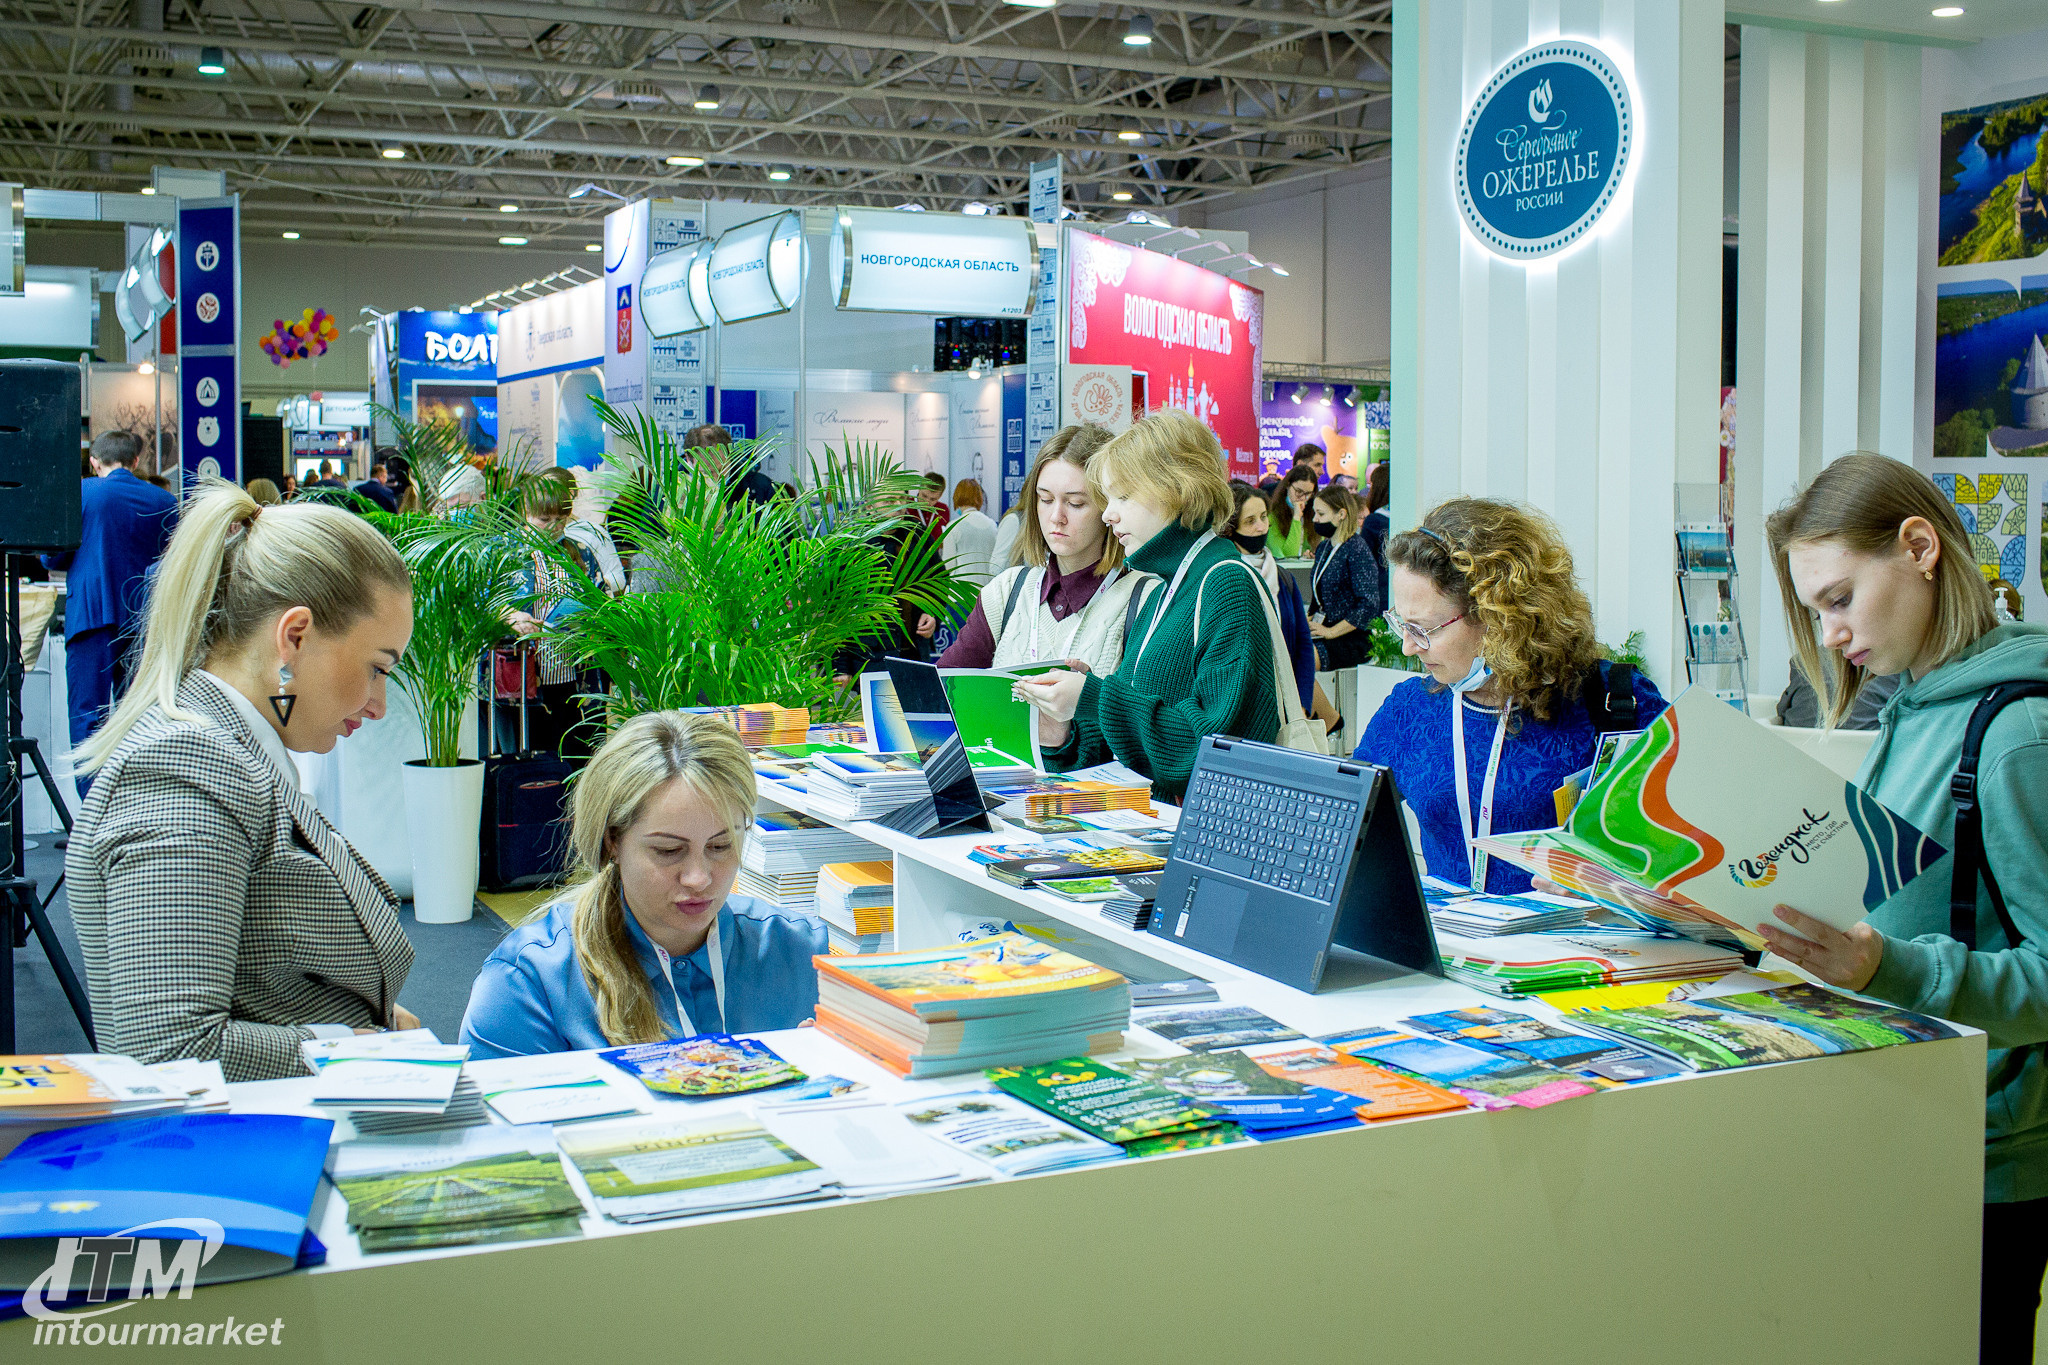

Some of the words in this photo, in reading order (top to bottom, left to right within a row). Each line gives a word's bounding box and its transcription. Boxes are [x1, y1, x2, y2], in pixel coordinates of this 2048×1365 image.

[1496, 110, 1582, 166] Серебряное
[1483, 151, 1600, 199] ОЖЕРЕЛЬЕ
[1516, 191, 1564, 212] РОССИИ
[861, 254, 960, 269] НОВГОРОДСКАЯ
[964, 260, 1020, 272] ОБЛАСТЬ
[1124, 293, 1196, 350] ВОЛОГОДСКАЯ
[1196, 311, 1233, 355] ОБЛАСТЬ
[1739, 808, 1830, 880] Геленджик
[1804, 830, 1827, 848] место,
[1826, 820, 1838, 832] где
[1822, 821, 1849, 845] счастлив
[0, 1065, 70, 1075] EL
